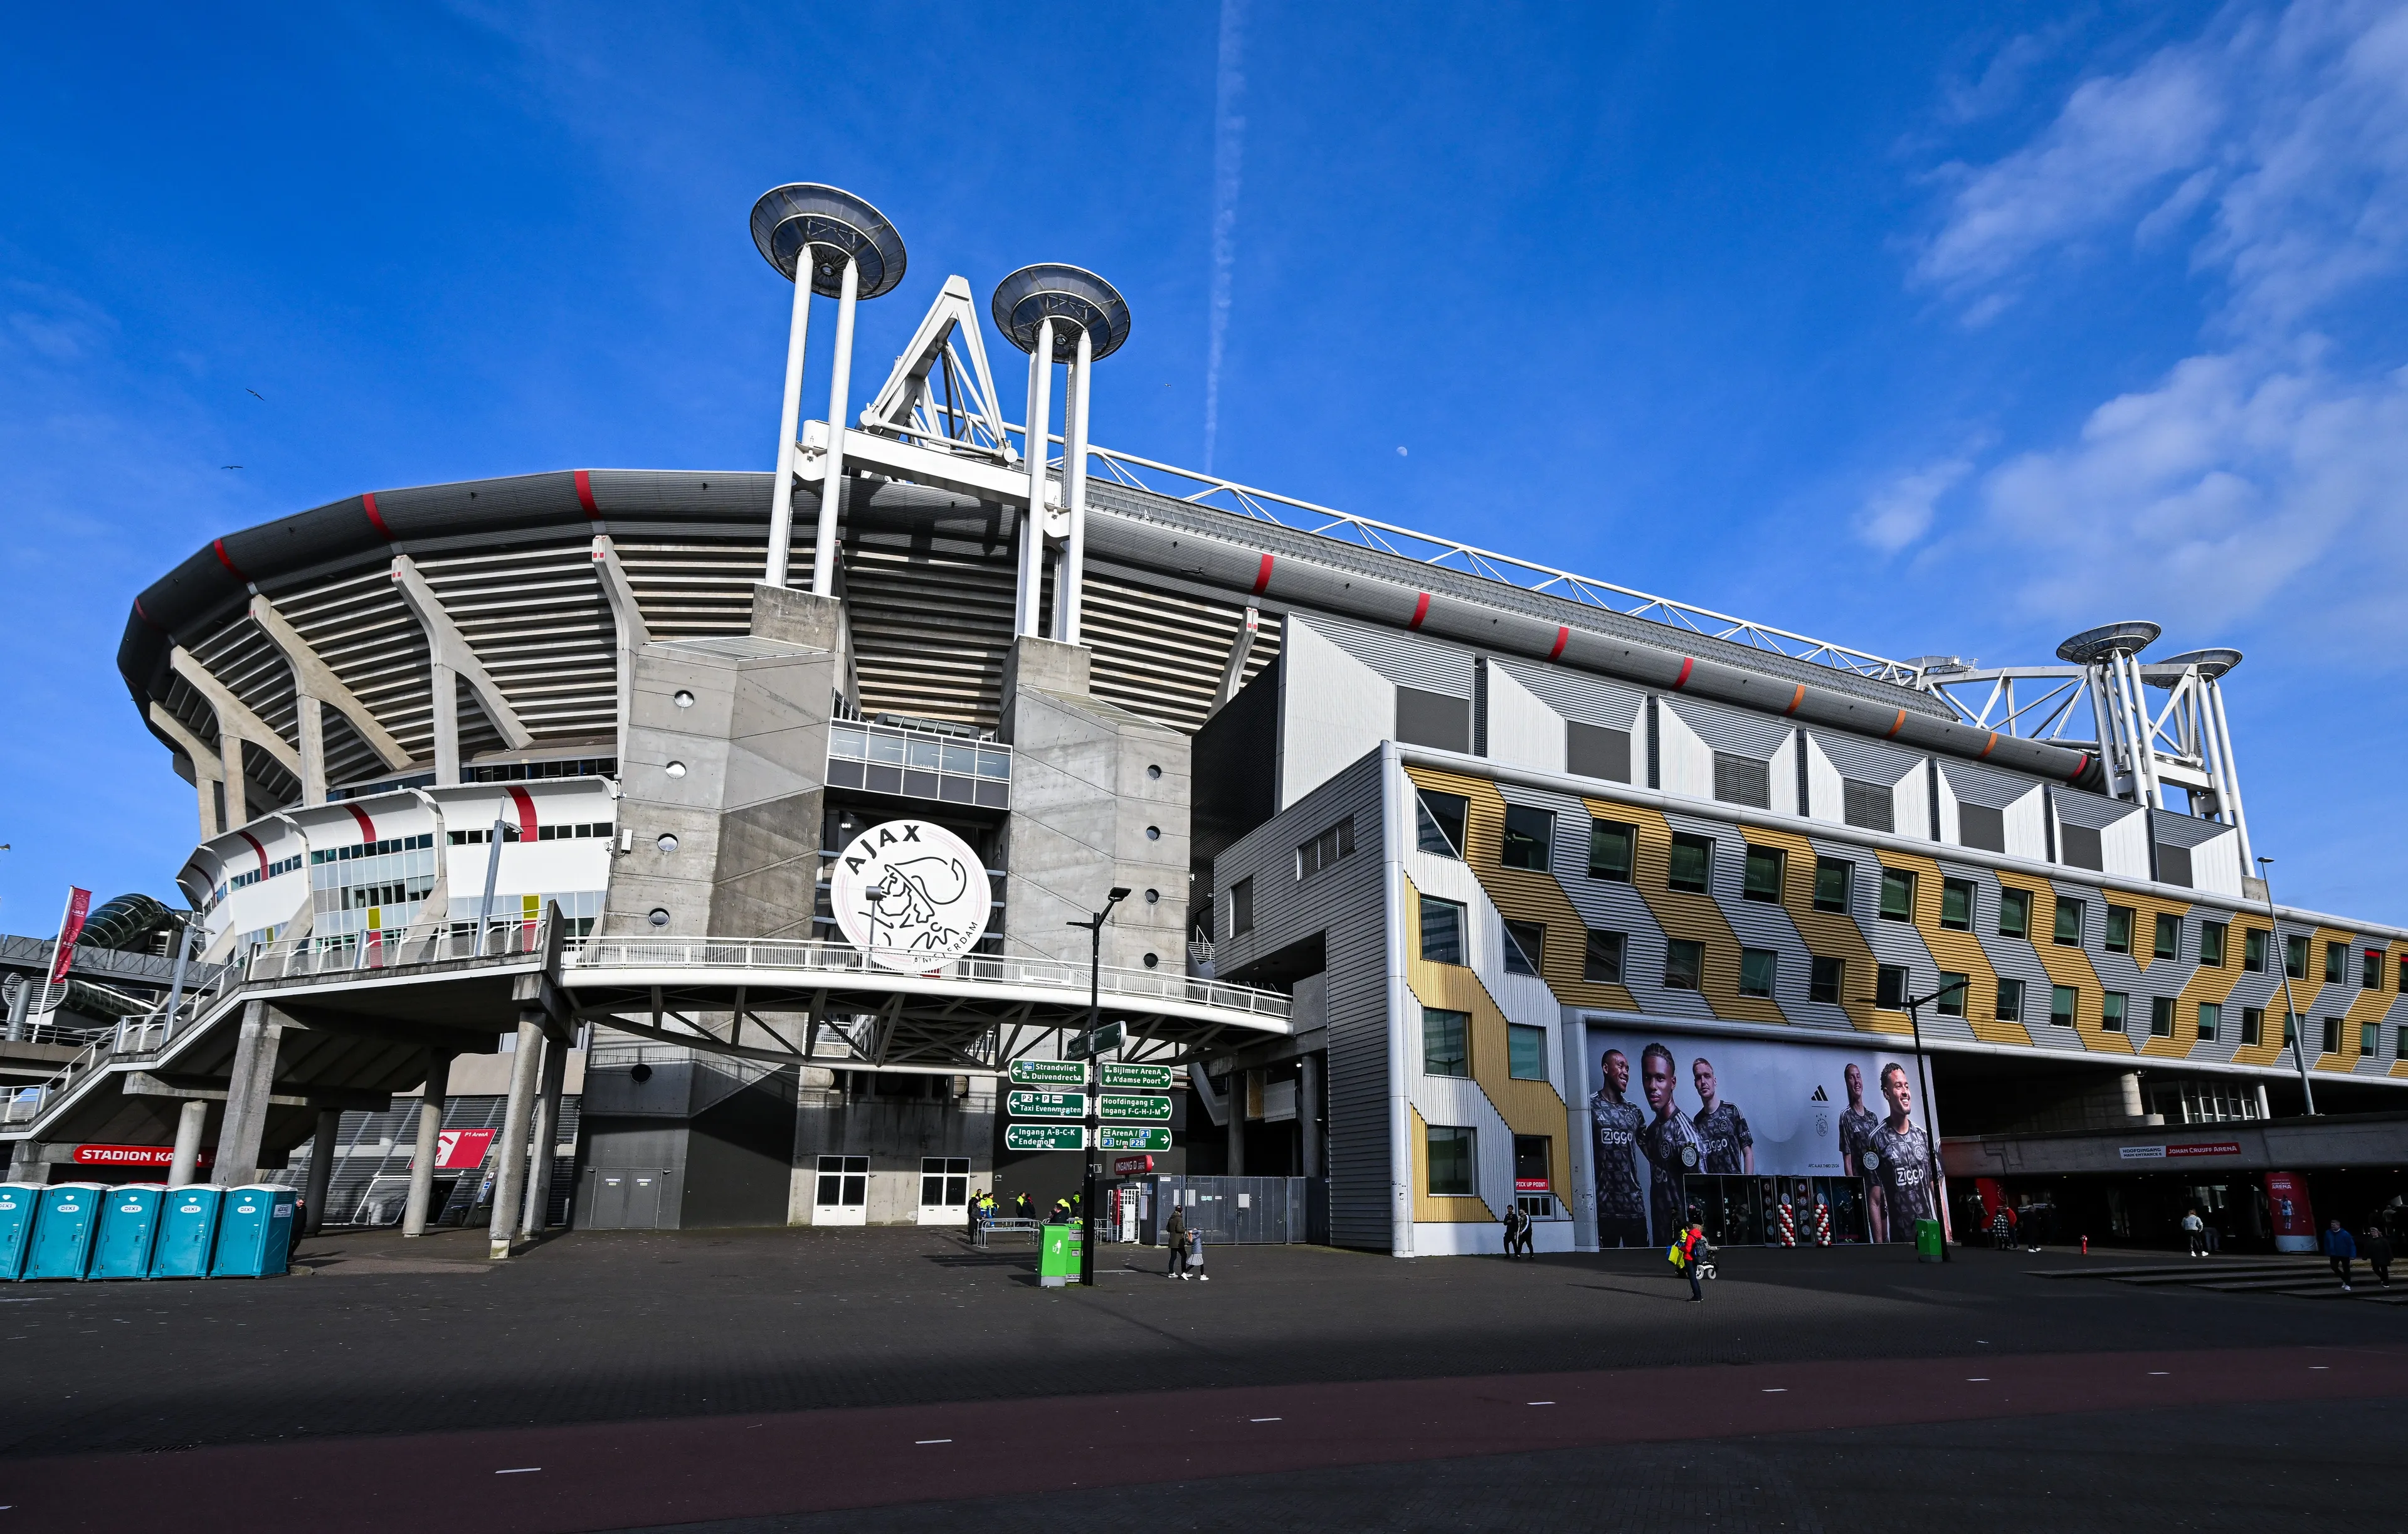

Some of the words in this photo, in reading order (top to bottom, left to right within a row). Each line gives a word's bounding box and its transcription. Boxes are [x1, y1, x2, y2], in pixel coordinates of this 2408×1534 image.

[845, 825, 921, 875] AJAX
[1103, 1098, 1148, 1106] Hoofdingang
[82, 1150, 151, 1161] STADION
[1116, 1161, 1133, 1171] INGANG
[1133, 1160, 1137, 1170] D
